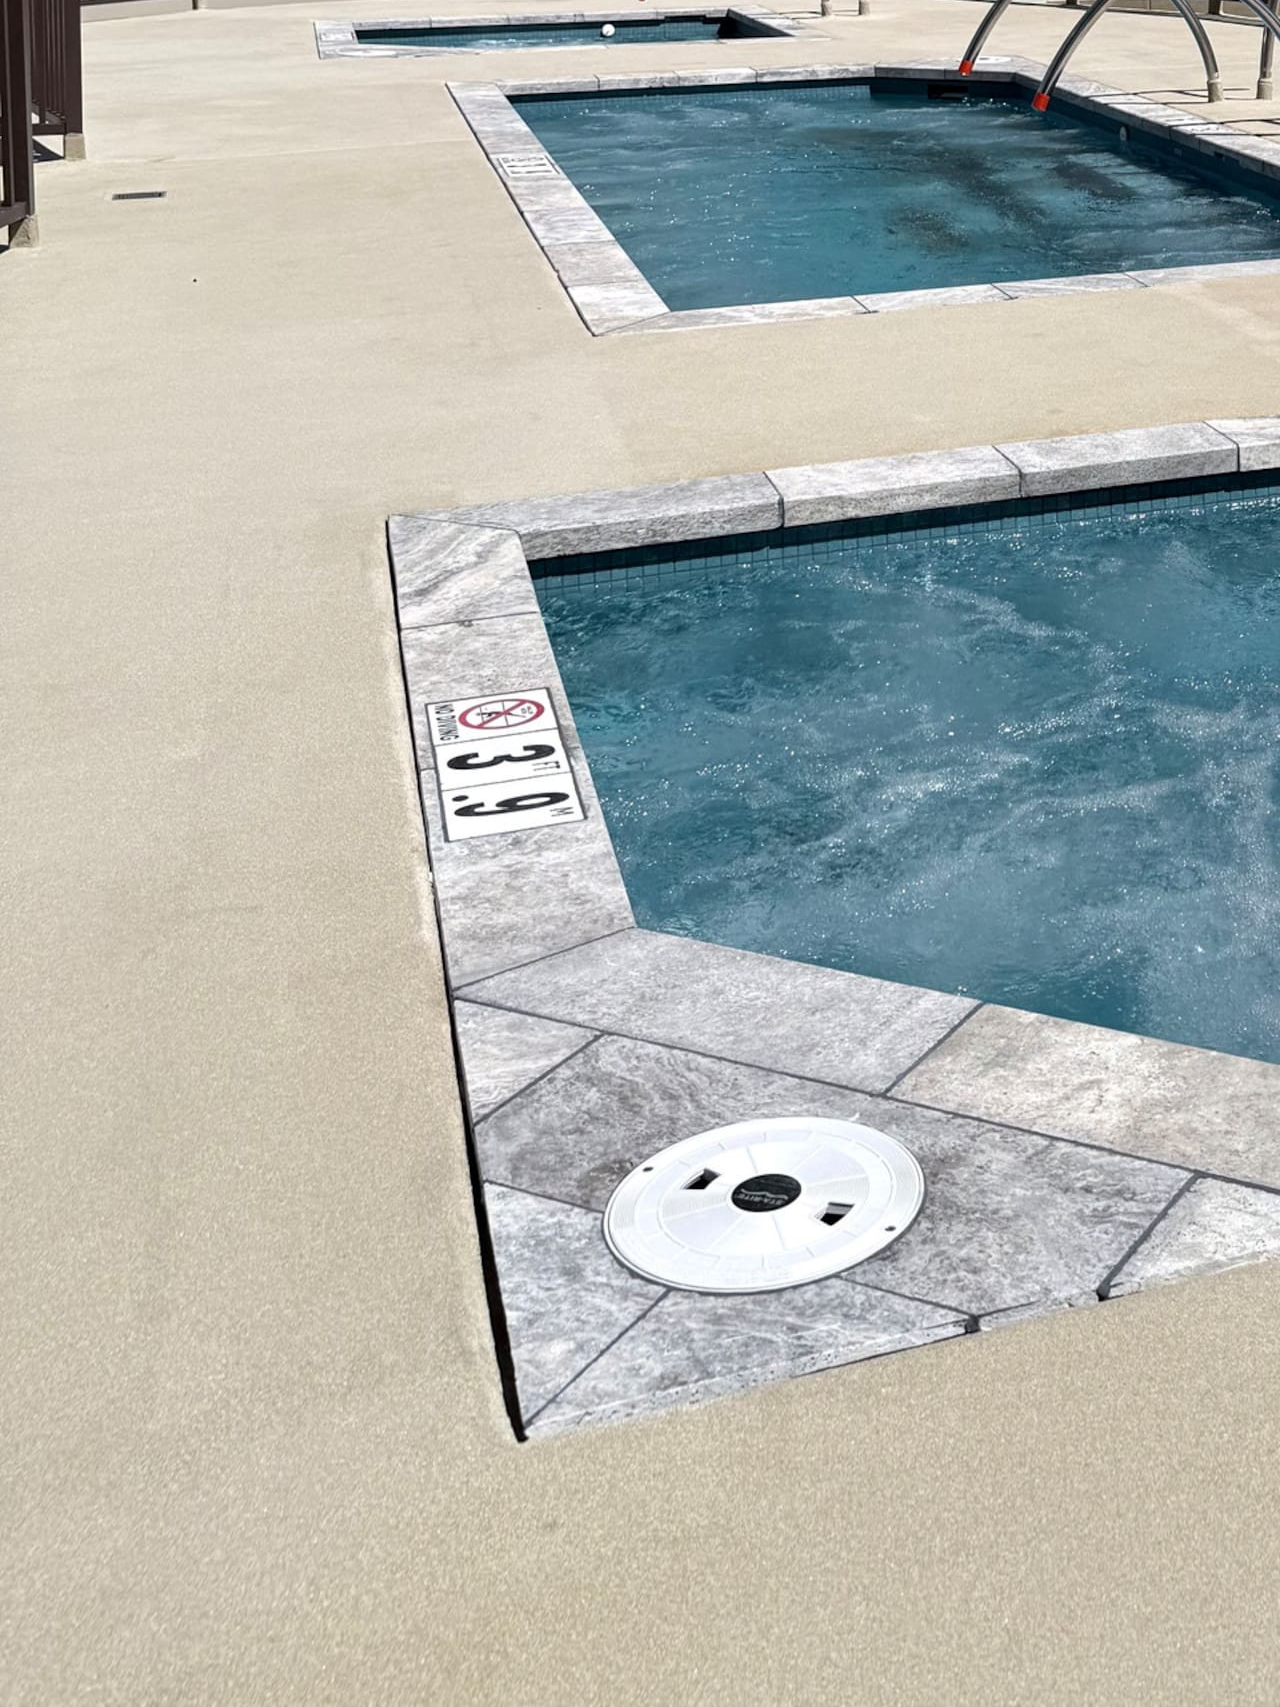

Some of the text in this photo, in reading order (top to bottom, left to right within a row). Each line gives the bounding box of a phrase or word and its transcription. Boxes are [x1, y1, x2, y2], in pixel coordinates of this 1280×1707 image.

[434, 703, 460, 741] NO DIVING
[446, 744, 556, 771] 3
